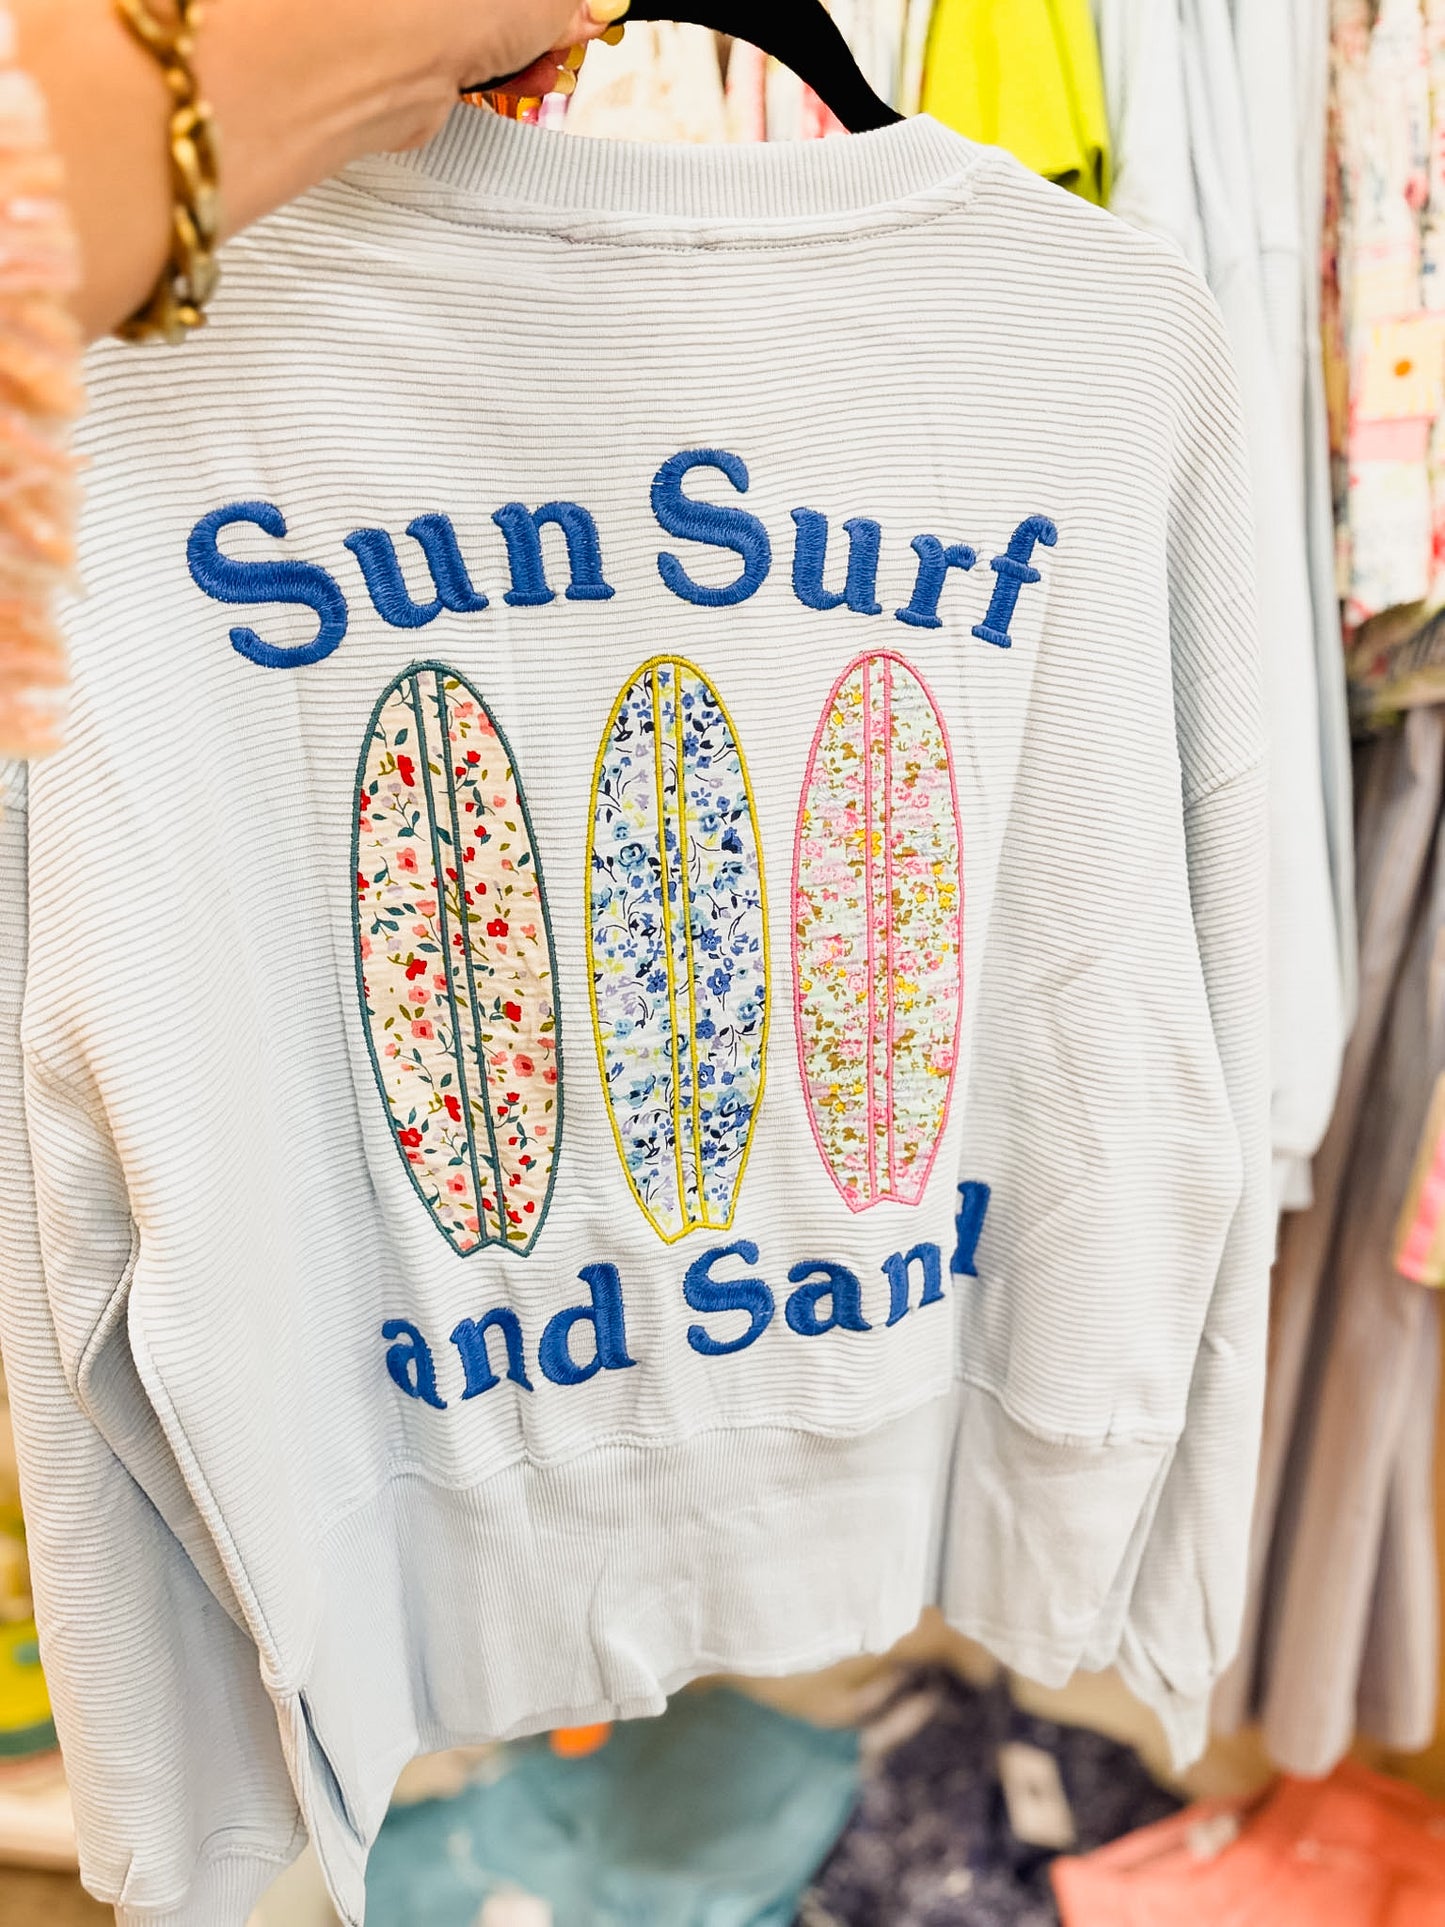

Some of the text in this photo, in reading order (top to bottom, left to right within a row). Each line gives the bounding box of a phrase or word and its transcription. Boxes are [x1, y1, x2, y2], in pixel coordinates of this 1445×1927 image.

[187, 449, 1057, 669] Sun Surf
[382, 1263, 637, 1410] and
